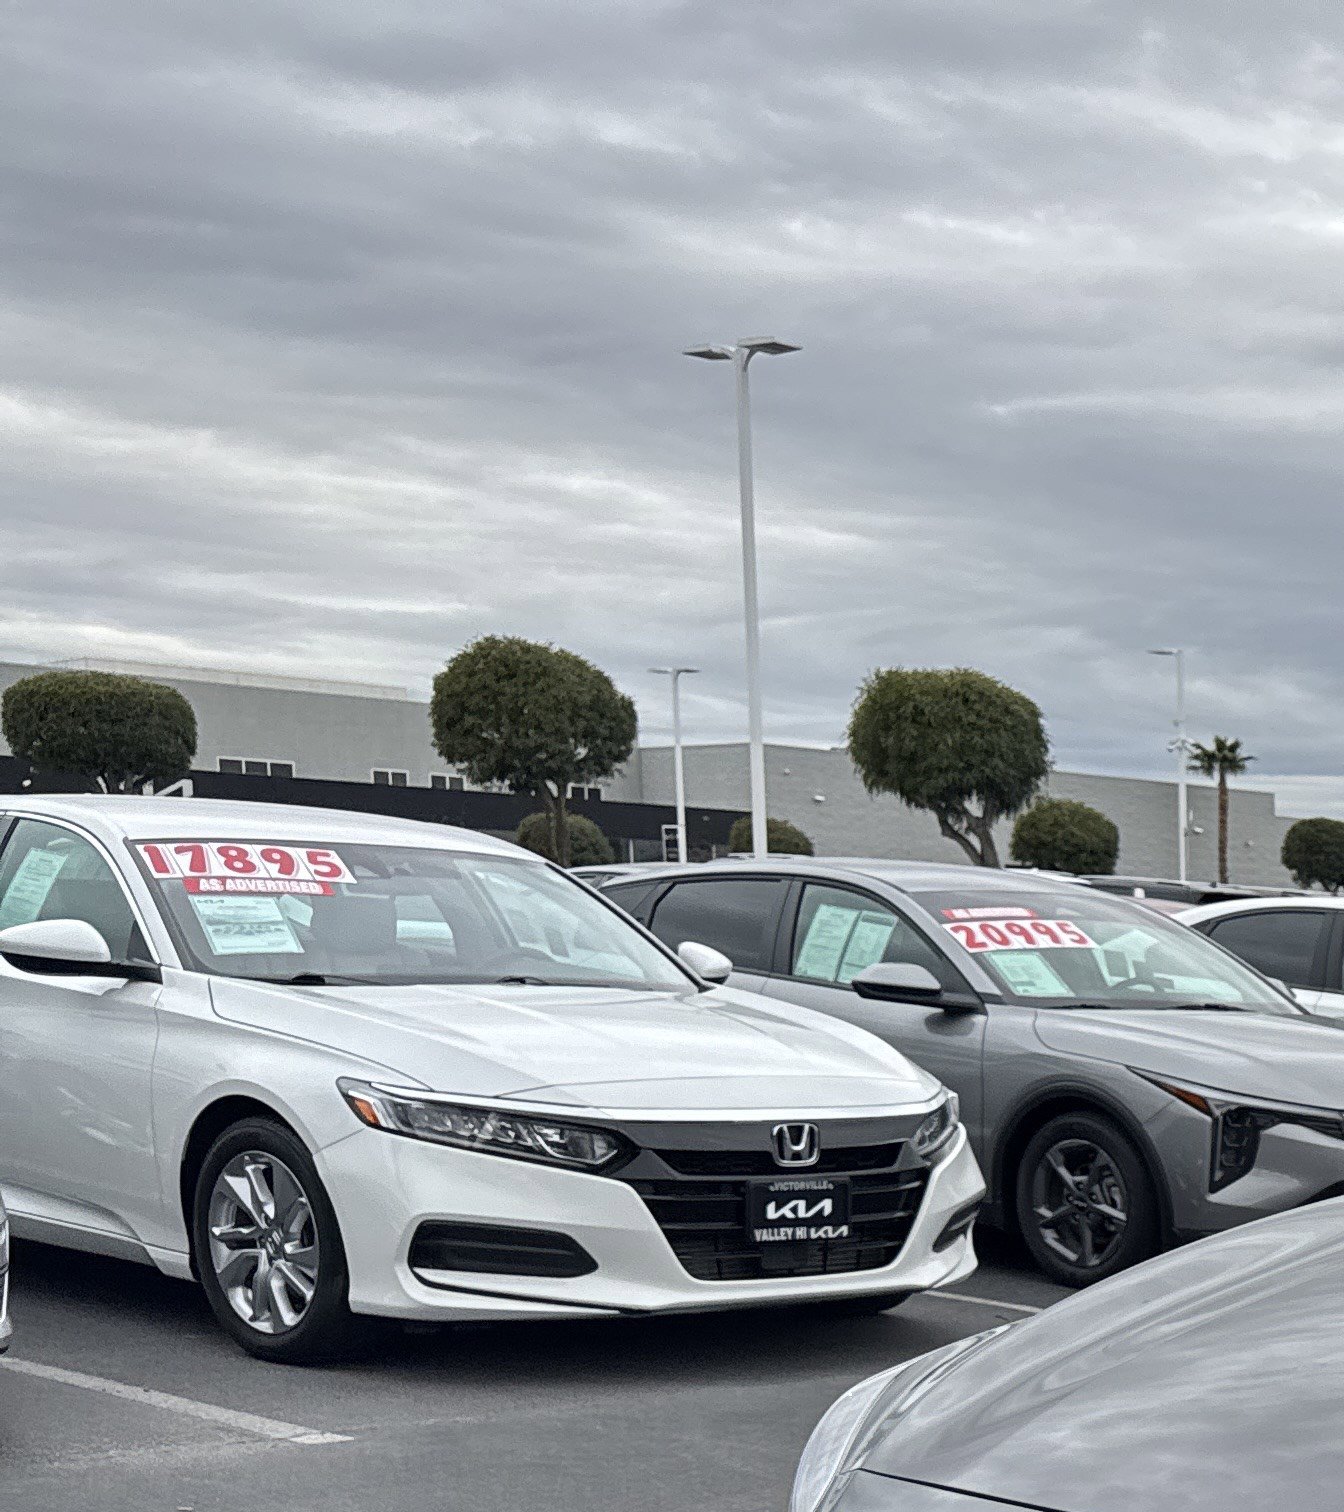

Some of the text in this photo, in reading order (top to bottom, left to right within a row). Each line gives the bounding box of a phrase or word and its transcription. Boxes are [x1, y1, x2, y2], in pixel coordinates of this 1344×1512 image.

[143, 844, 344, 878] 17895
[199, 879, 324, 894] AS ADVERTISED
[950, 921, 1089, 949] 20995
[774, 1180, 829, 1191] VICTORVILLE
[766, 1198, 833, 1220] KIA
[754, 1225, 849, 1242] VALLEY HI KIA
